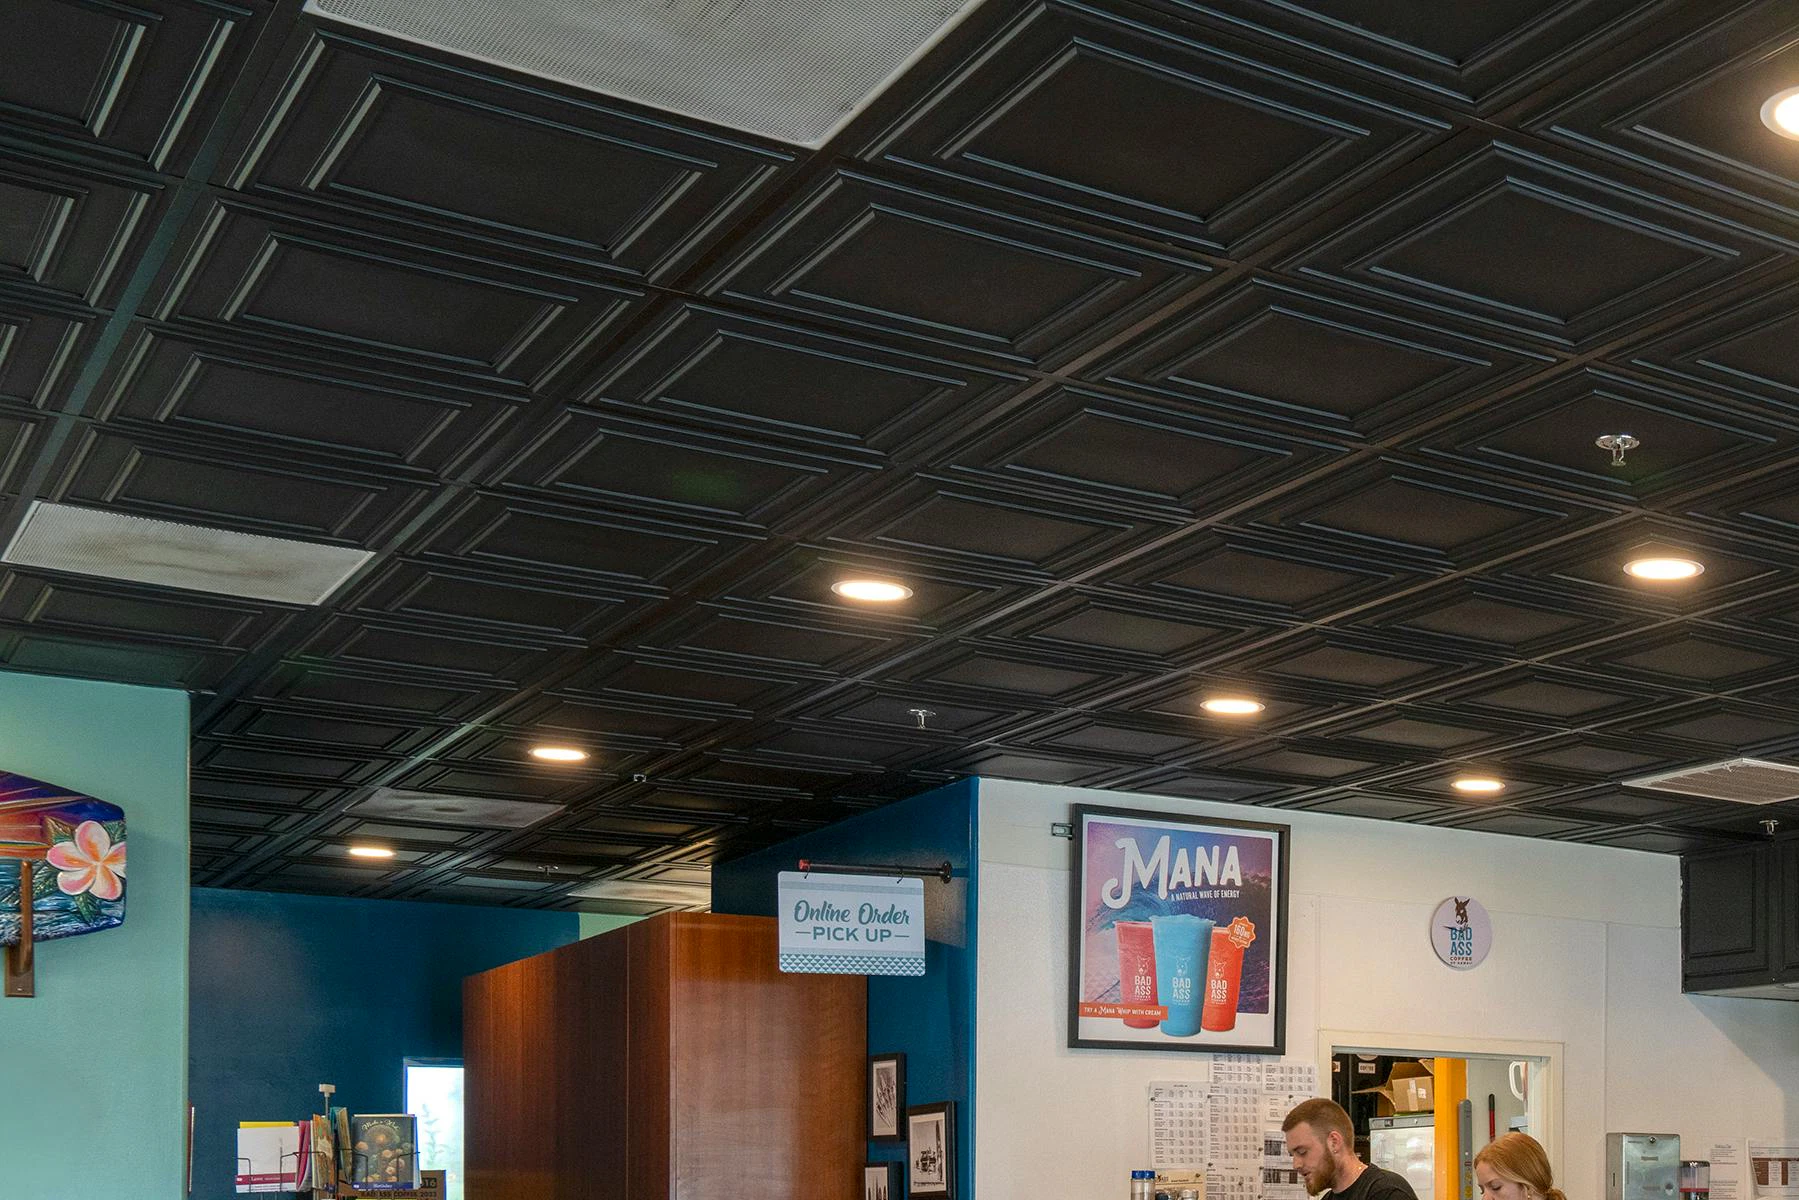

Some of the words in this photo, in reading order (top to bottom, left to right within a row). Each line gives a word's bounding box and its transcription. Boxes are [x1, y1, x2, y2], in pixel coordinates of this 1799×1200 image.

[1171, 893, 1176, 901] A
[1176, 891, 1198, 900] NATURAL
[1199, 891, 1212, 899] WAVE
[1213, 890, 1220, 898] OF
[1221, 889, 1240, 899] ENERGY
[794, 900, 850, 923] Online
[858, 903, 909, 925] Order
[813, 926, 859, 942] PICK
[866, 928, 892, 942] UP
[1450, 927, 1472, 940] BAD
[1450, 942, 1472, 955] ASS
[1134, 976, 1151, 985] BAD
[1172, 978, 1191, 988] BAD
[1211, 980, 1227, 989] BAD
[1135, 985, 1151, 995] ASS
[1172, 989, 1190, 999] ASS
[1211, 990, 1227, 999] ASS
